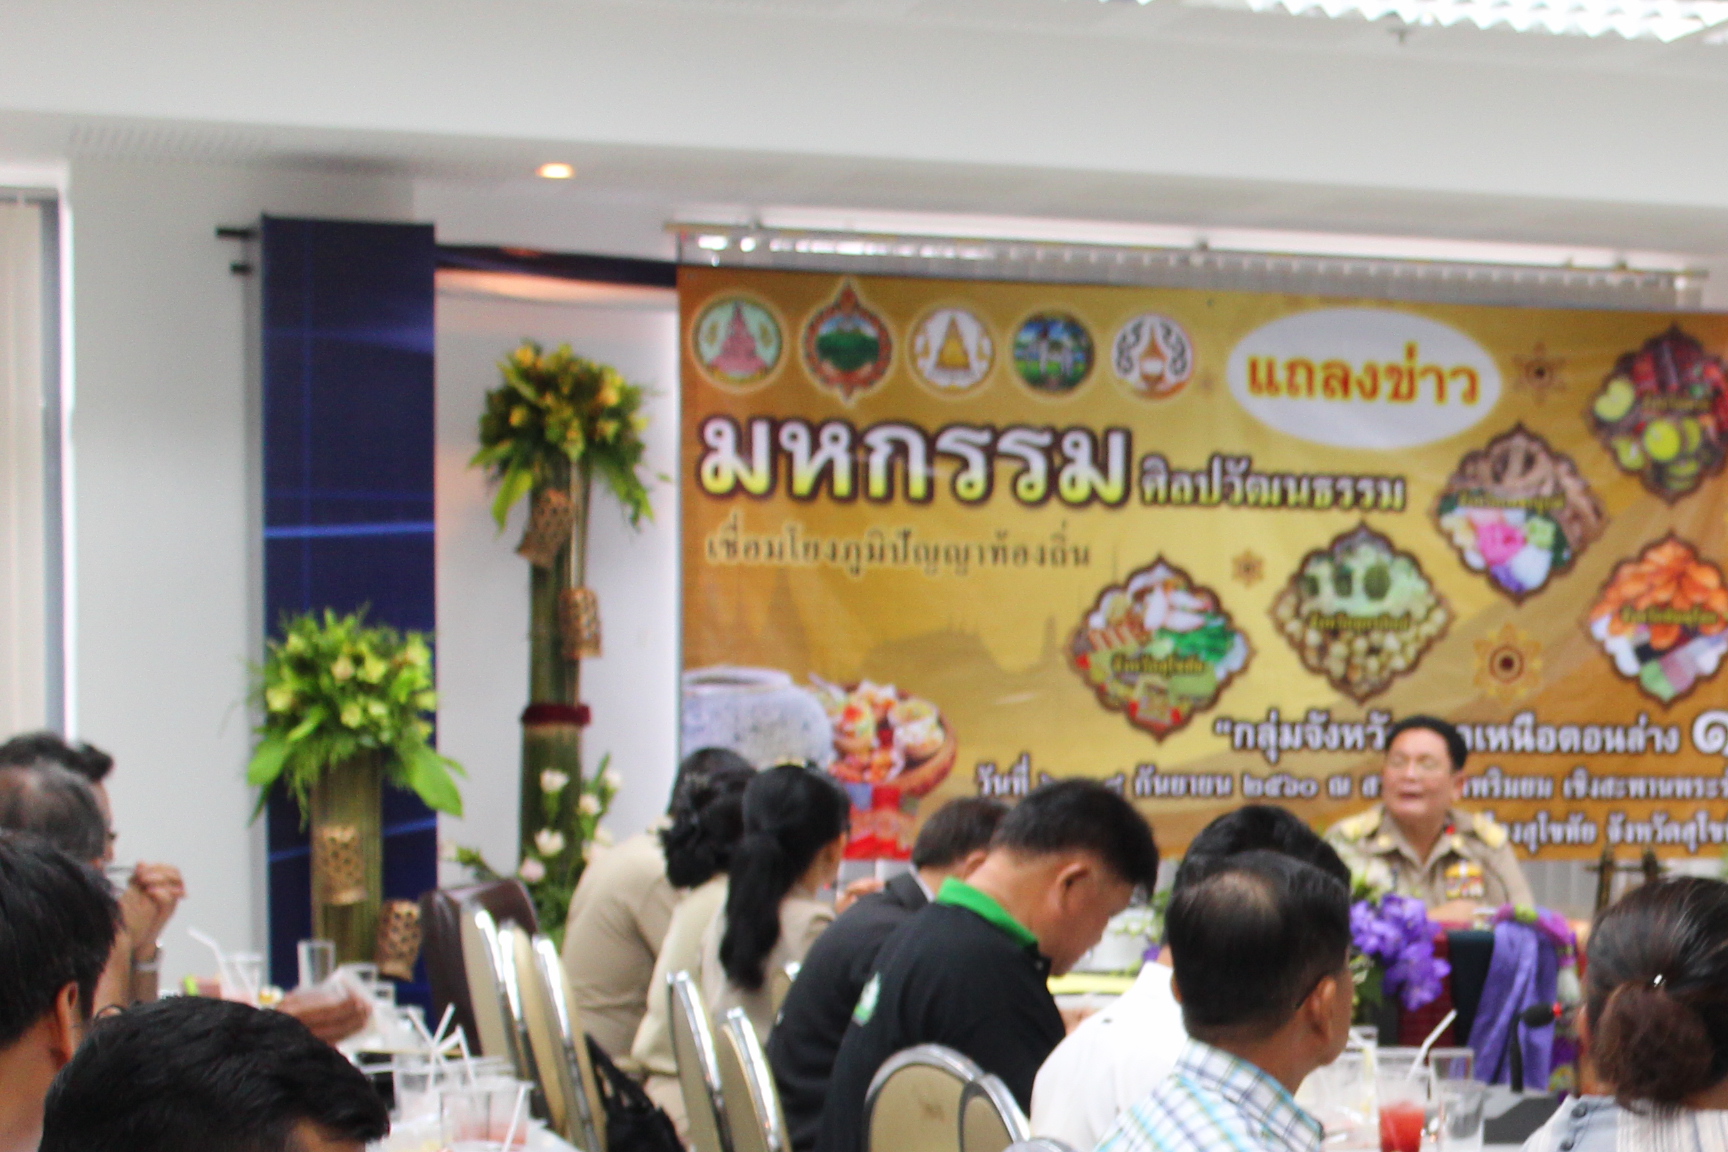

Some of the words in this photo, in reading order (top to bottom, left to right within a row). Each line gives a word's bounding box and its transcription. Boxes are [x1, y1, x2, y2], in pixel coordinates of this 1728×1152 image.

[1247, 341, 1481, 405] แถลงข่าว
[699, 415, 1131, 506] มหกรรม
[706, 512, 1091, 576] เชื่อมโยงภูมิปัญญาท้องถิ่น
[1134, 763, 1233, 797] กันยายน
